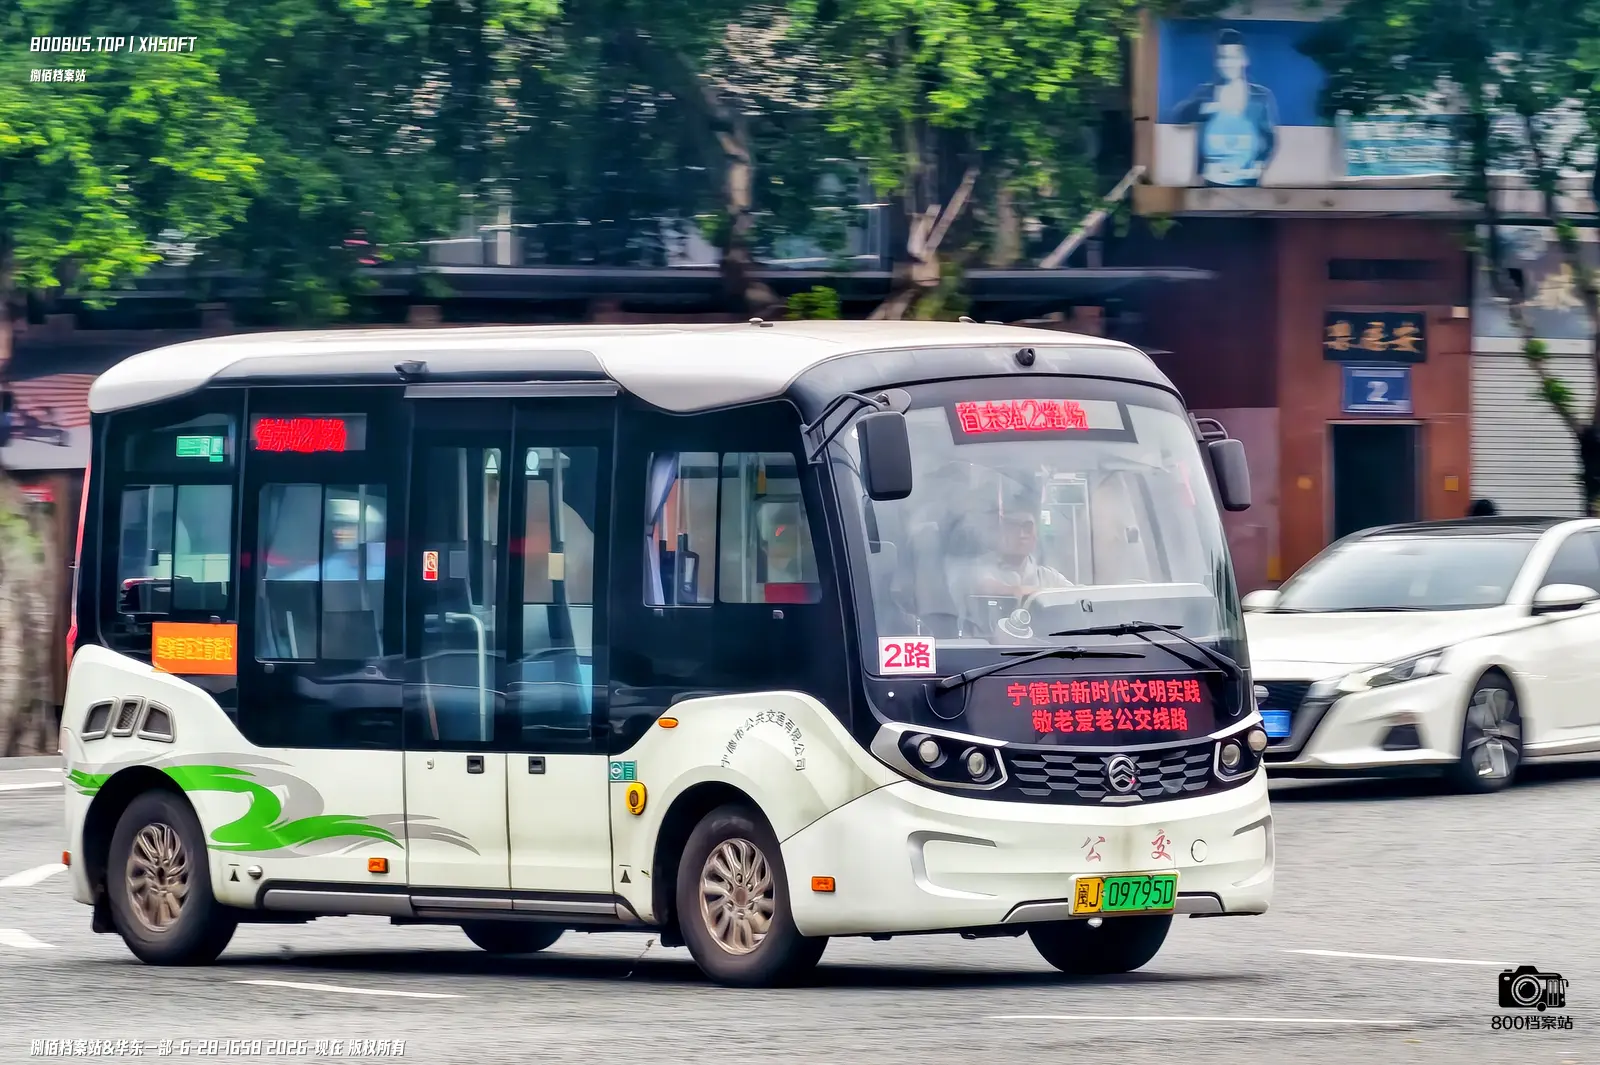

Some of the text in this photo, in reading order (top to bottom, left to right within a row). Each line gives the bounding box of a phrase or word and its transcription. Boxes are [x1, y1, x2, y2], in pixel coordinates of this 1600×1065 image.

[1366, 381, 1389, 402] 2
[884, 641, 931, 669] 2路
[1007, 679, 1201, 706] 宁德市新时代文明实践
[1031, 706, 1189, 733] 敬老爱老公交线路
